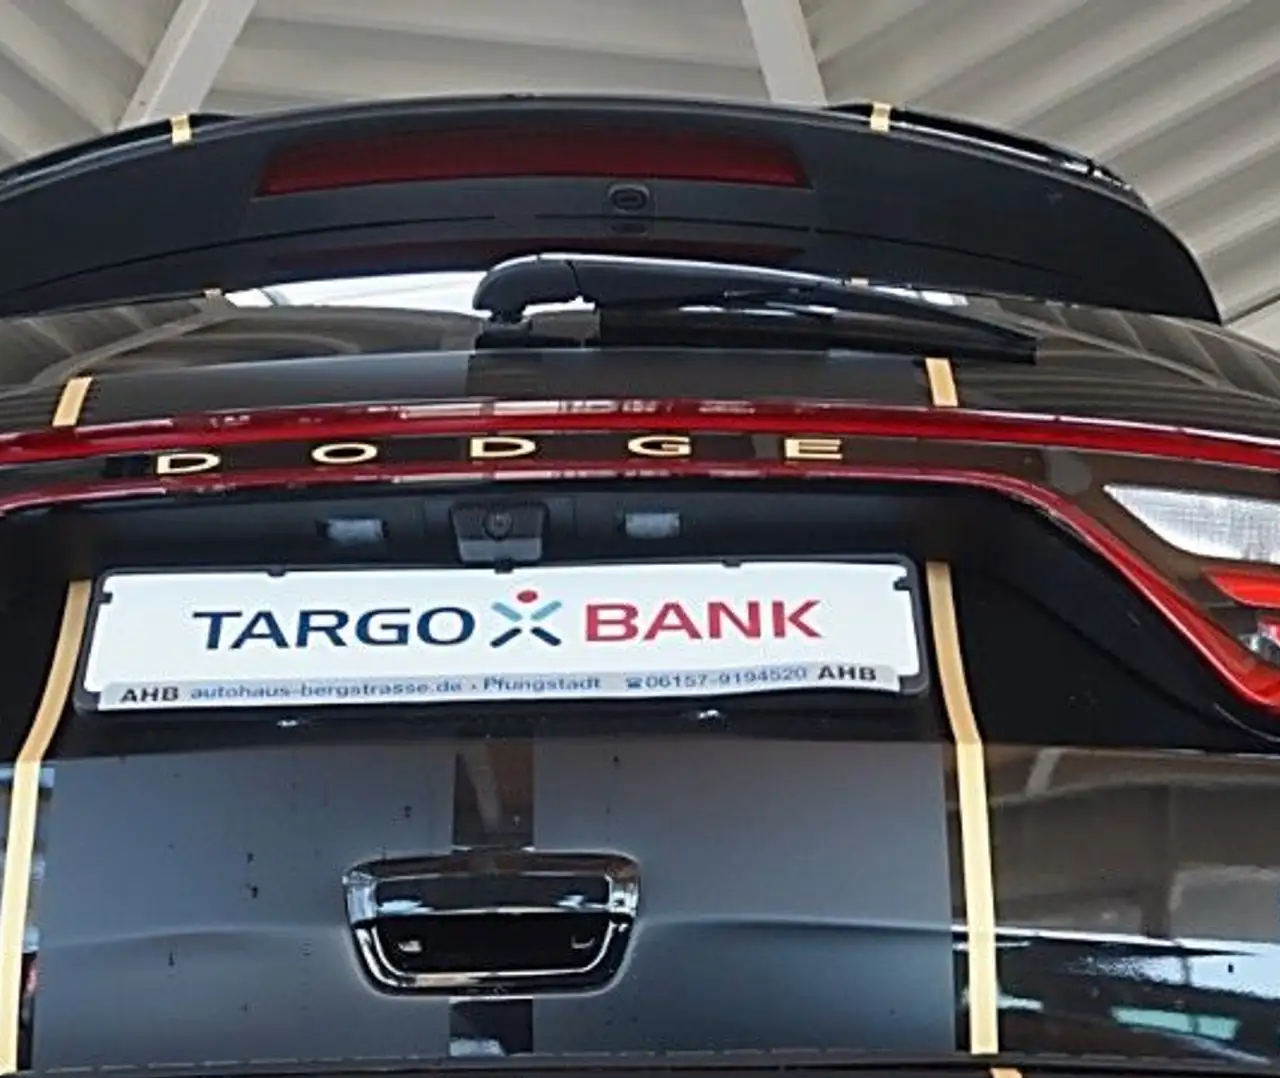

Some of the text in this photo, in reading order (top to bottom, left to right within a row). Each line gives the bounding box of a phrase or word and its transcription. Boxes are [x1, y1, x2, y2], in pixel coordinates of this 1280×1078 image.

[156, 436, 844, 474] DODGE
[119, 686, 179, 704] AHB
[190, 674, 462, 699] autohaus-bergstrasse.de
[483, 675, 602, 693] Pfungstadt
[817, 664, 877, 682] AHB
